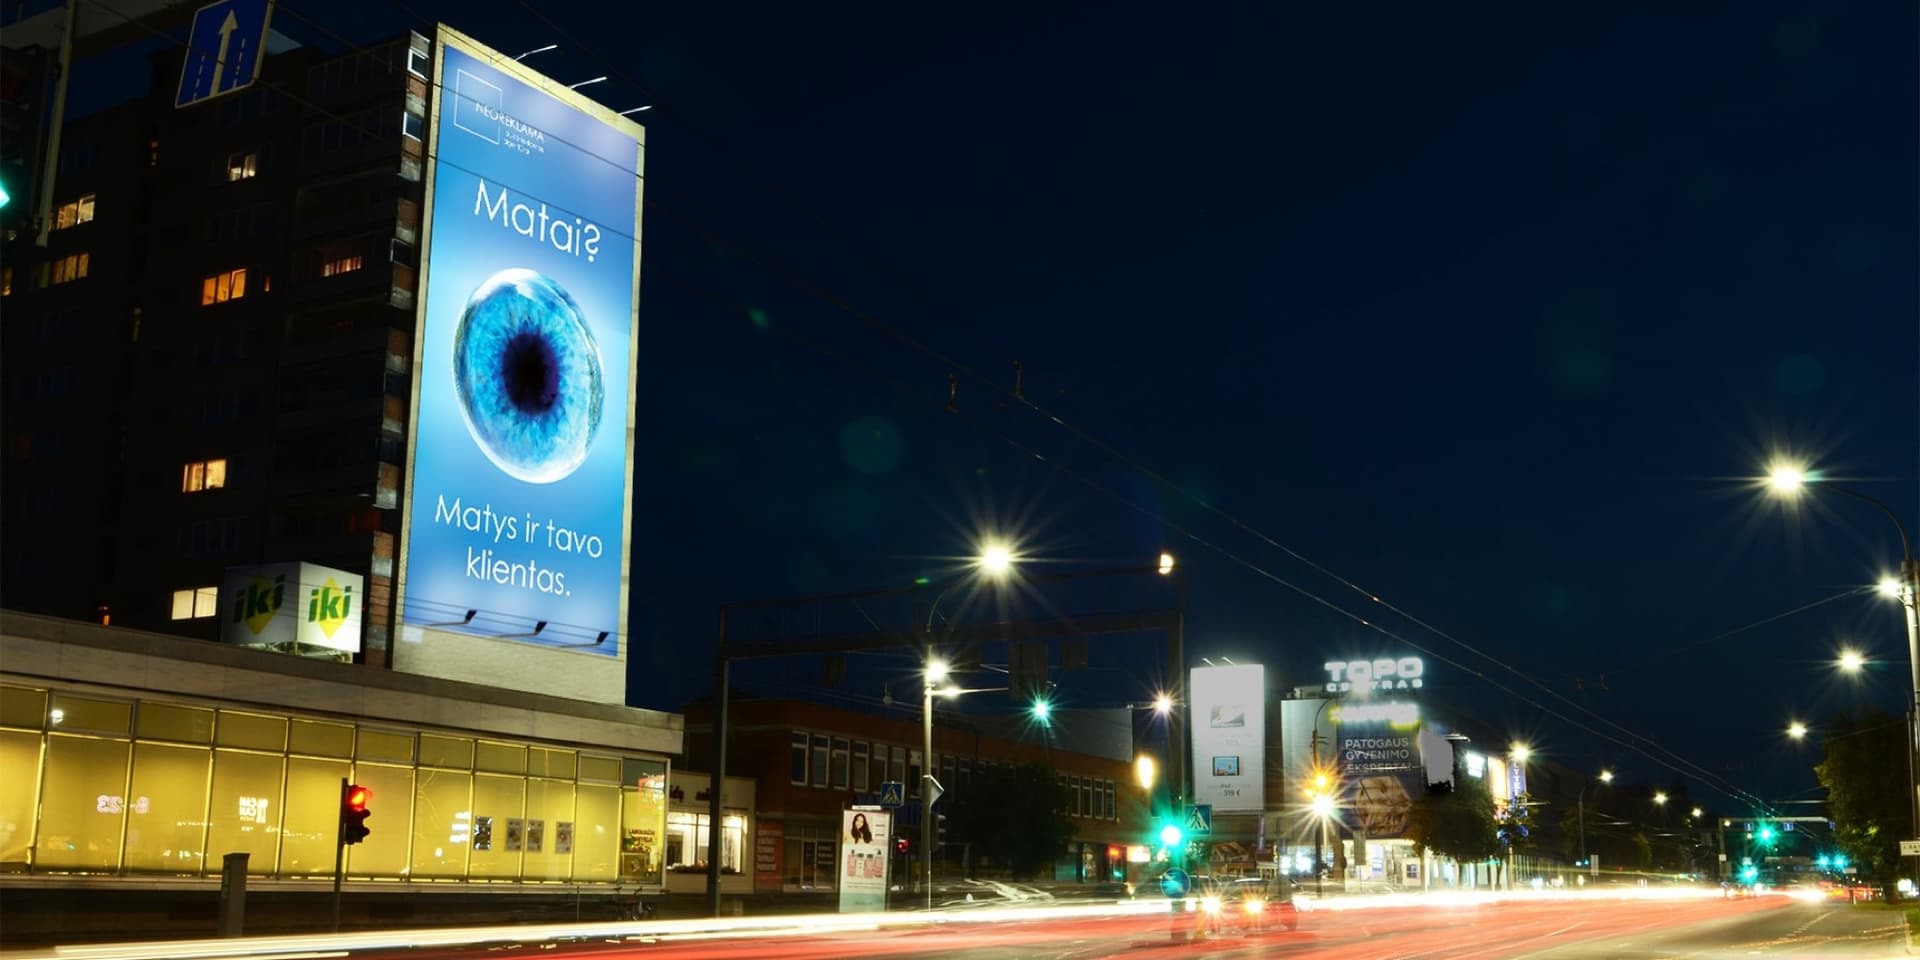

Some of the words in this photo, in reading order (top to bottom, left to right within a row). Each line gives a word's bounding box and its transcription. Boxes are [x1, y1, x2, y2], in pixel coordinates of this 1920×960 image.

[475, 102, 545, 145] NEOREKLAMA
[474, 177, 601, 262] Matai?
[435, 494, 517, 543] Matys
[525, 512, 540, 543] ir
[546, 519, 603, 558] tavo
[466, 546, 571, 597] klientas.
[232, 575, 285, 624] iki
[308, 585, 352, 623] iki
[1324, 657, 1423, 682] TOPO
[1344, 737, 1409, 750] PATOGAUS
[1345, 749, 1409, 761] GYVENIMO
